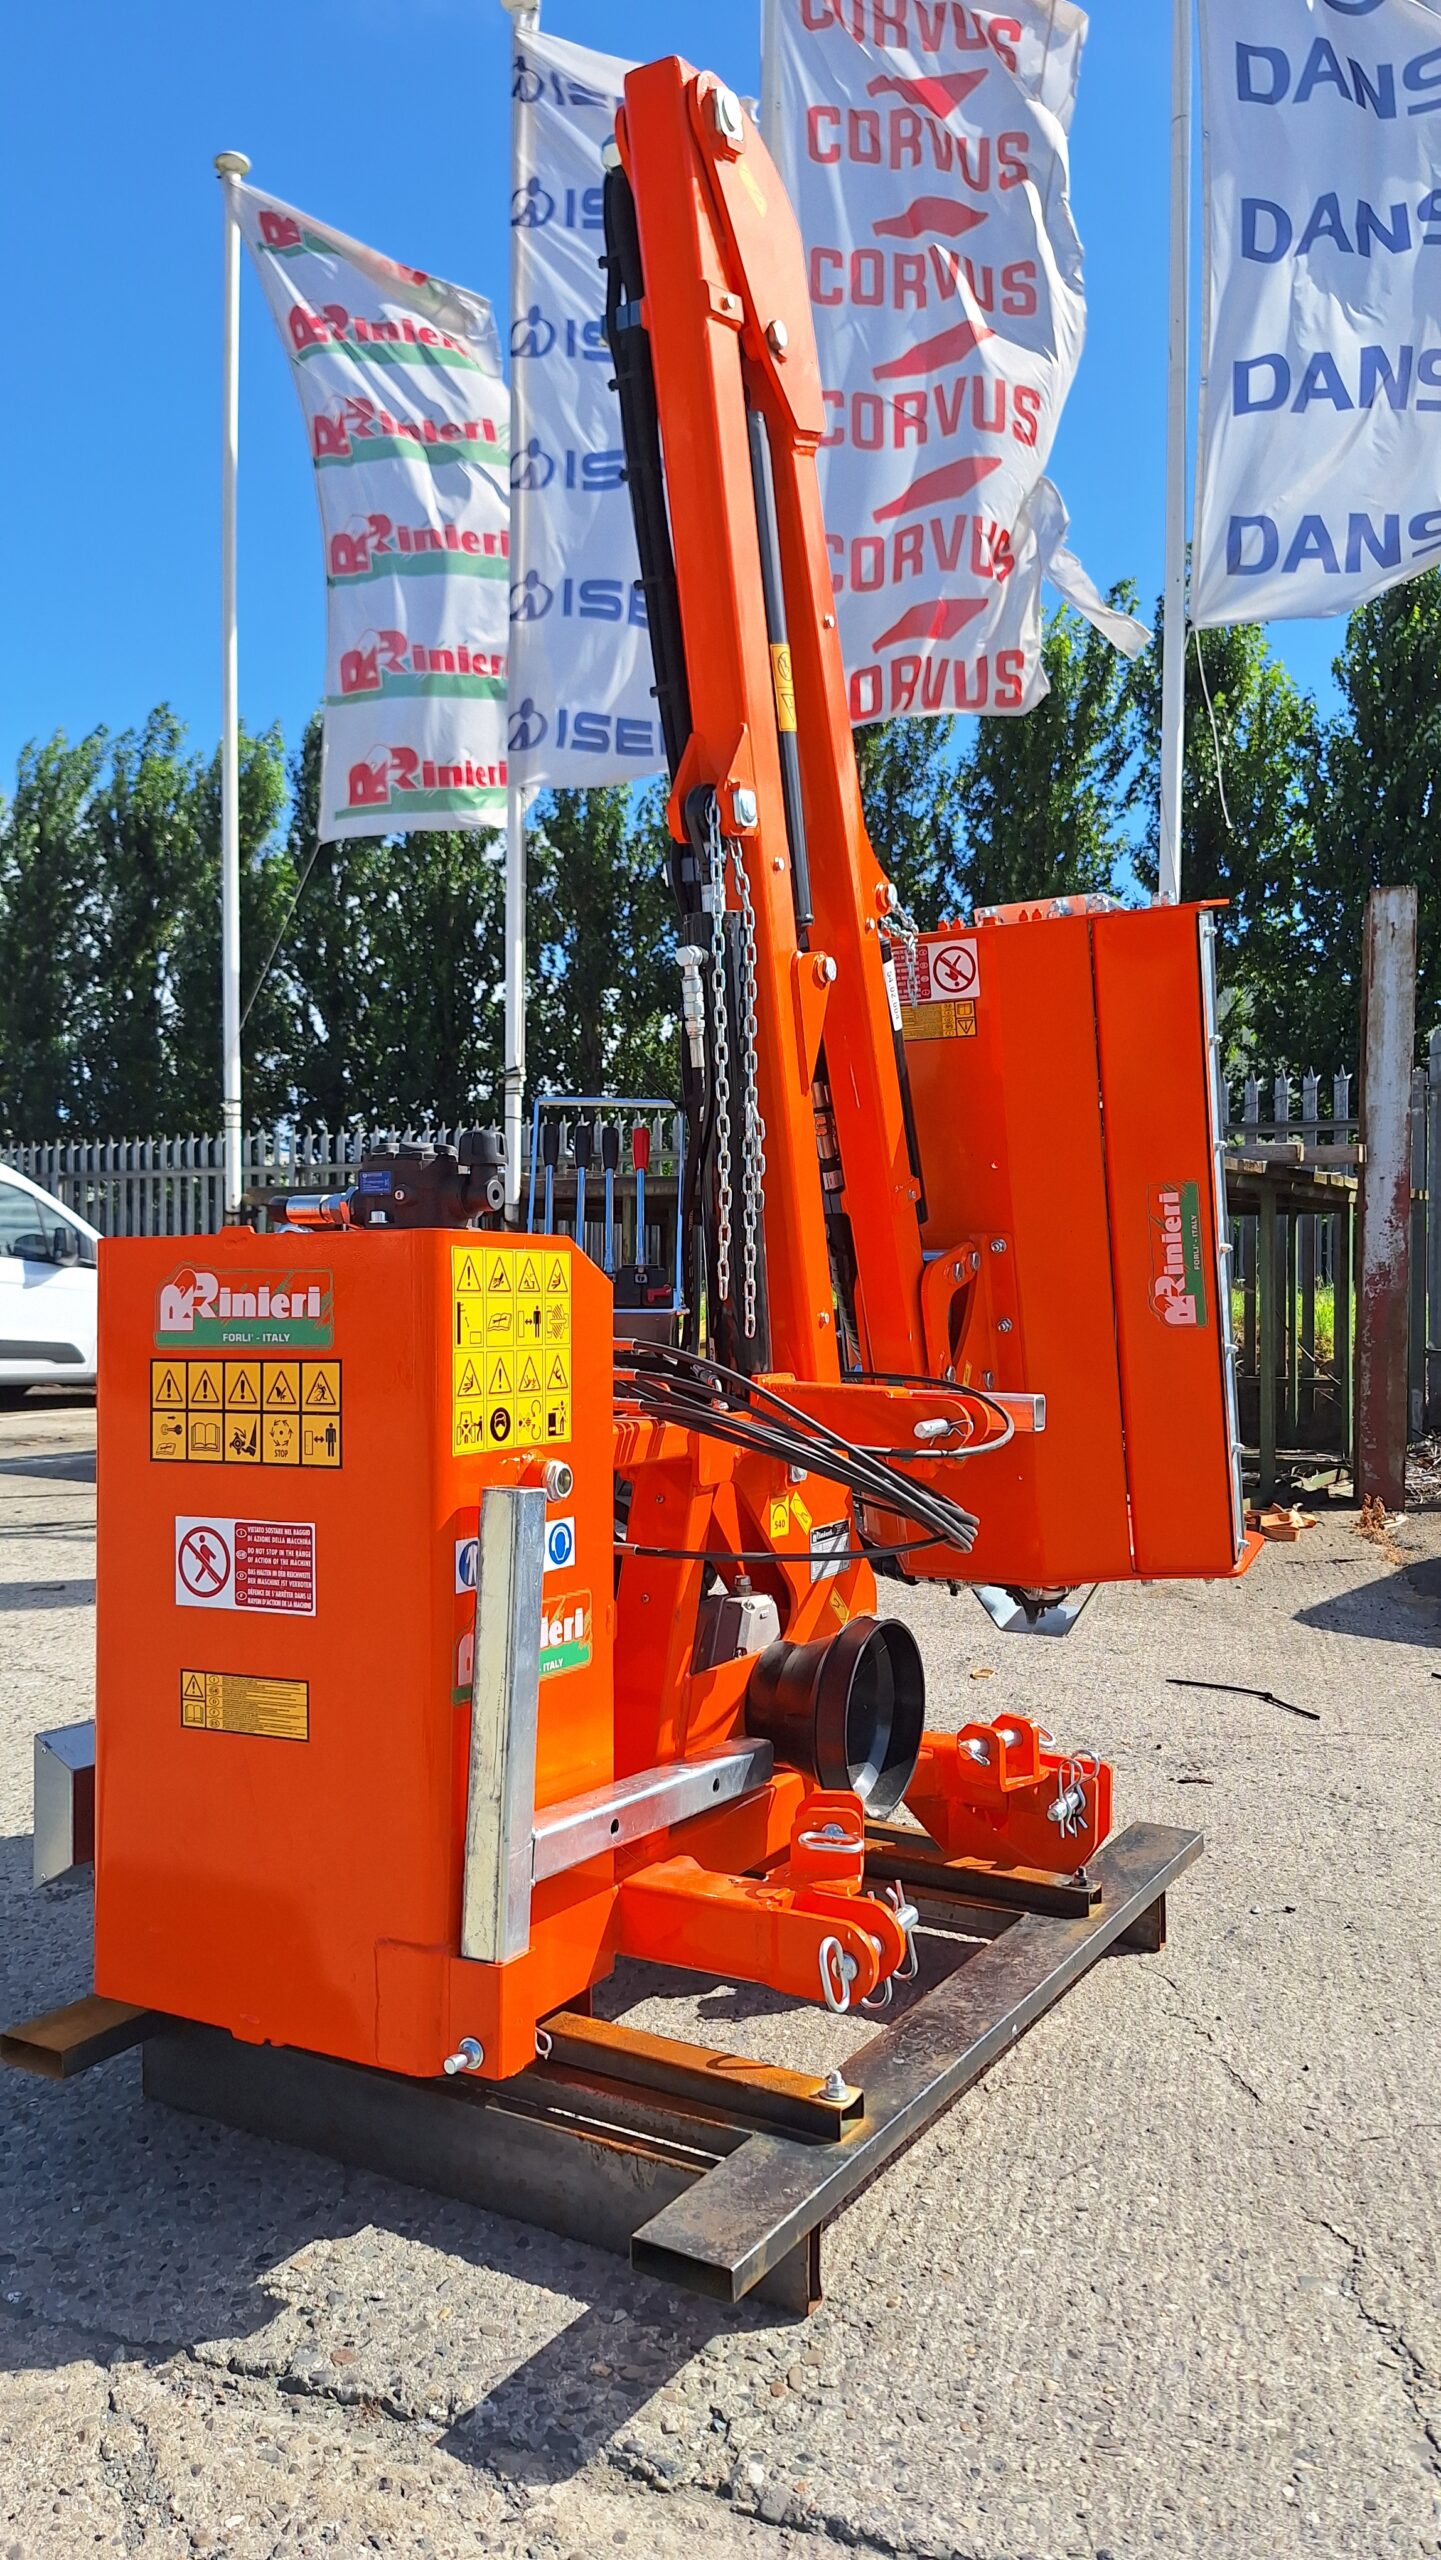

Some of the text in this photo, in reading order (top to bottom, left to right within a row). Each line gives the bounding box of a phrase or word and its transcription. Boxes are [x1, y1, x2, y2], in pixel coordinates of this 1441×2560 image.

[801, 0, 1022, 73] CORVUS
[1235, 37, 1441, 120] DANS
[807, 106, 1030, 192] CORVUS
[810, 244, 1037, 316] CORVUS
[821, 375, 1041, 448] CORVUS
[1227, 510, 1441, 576] DANS
[341, 629, 508, 694] Rinier
[556, 709, 666, 757] ISE
[262, 1333, 289, 1342] ITALY
[274, 1449, 288, 1458] STOP
[543, 1658, 564, 1672] ITALY
